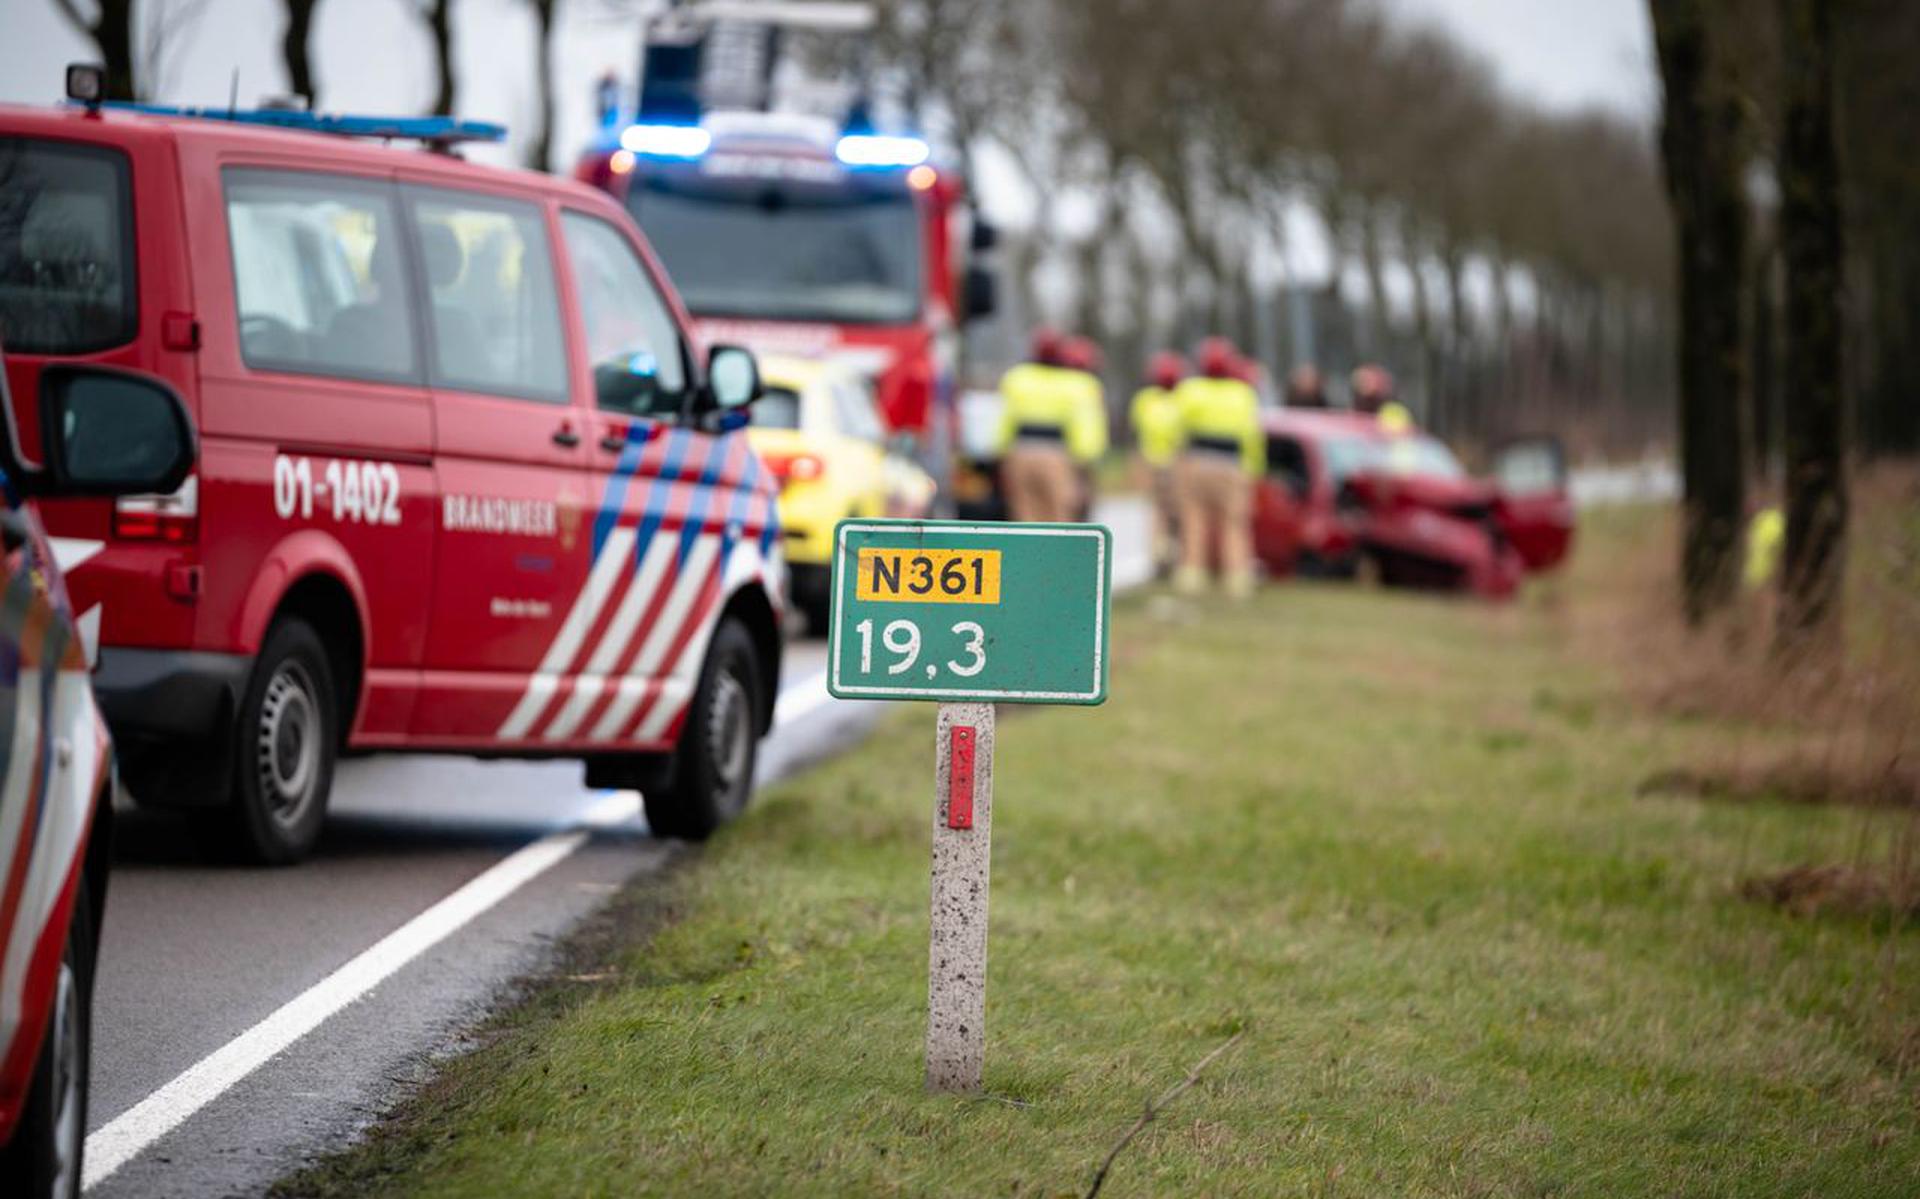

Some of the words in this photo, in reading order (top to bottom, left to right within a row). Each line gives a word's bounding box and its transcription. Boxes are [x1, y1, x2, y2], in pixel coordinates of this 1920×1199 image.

[273, 454, 401, 524] 01-1402
[443, 494, 555, 535] BRANDWEER
[871, 556, 984, 595] N361
[856, 618, 987, 680] 19,3
